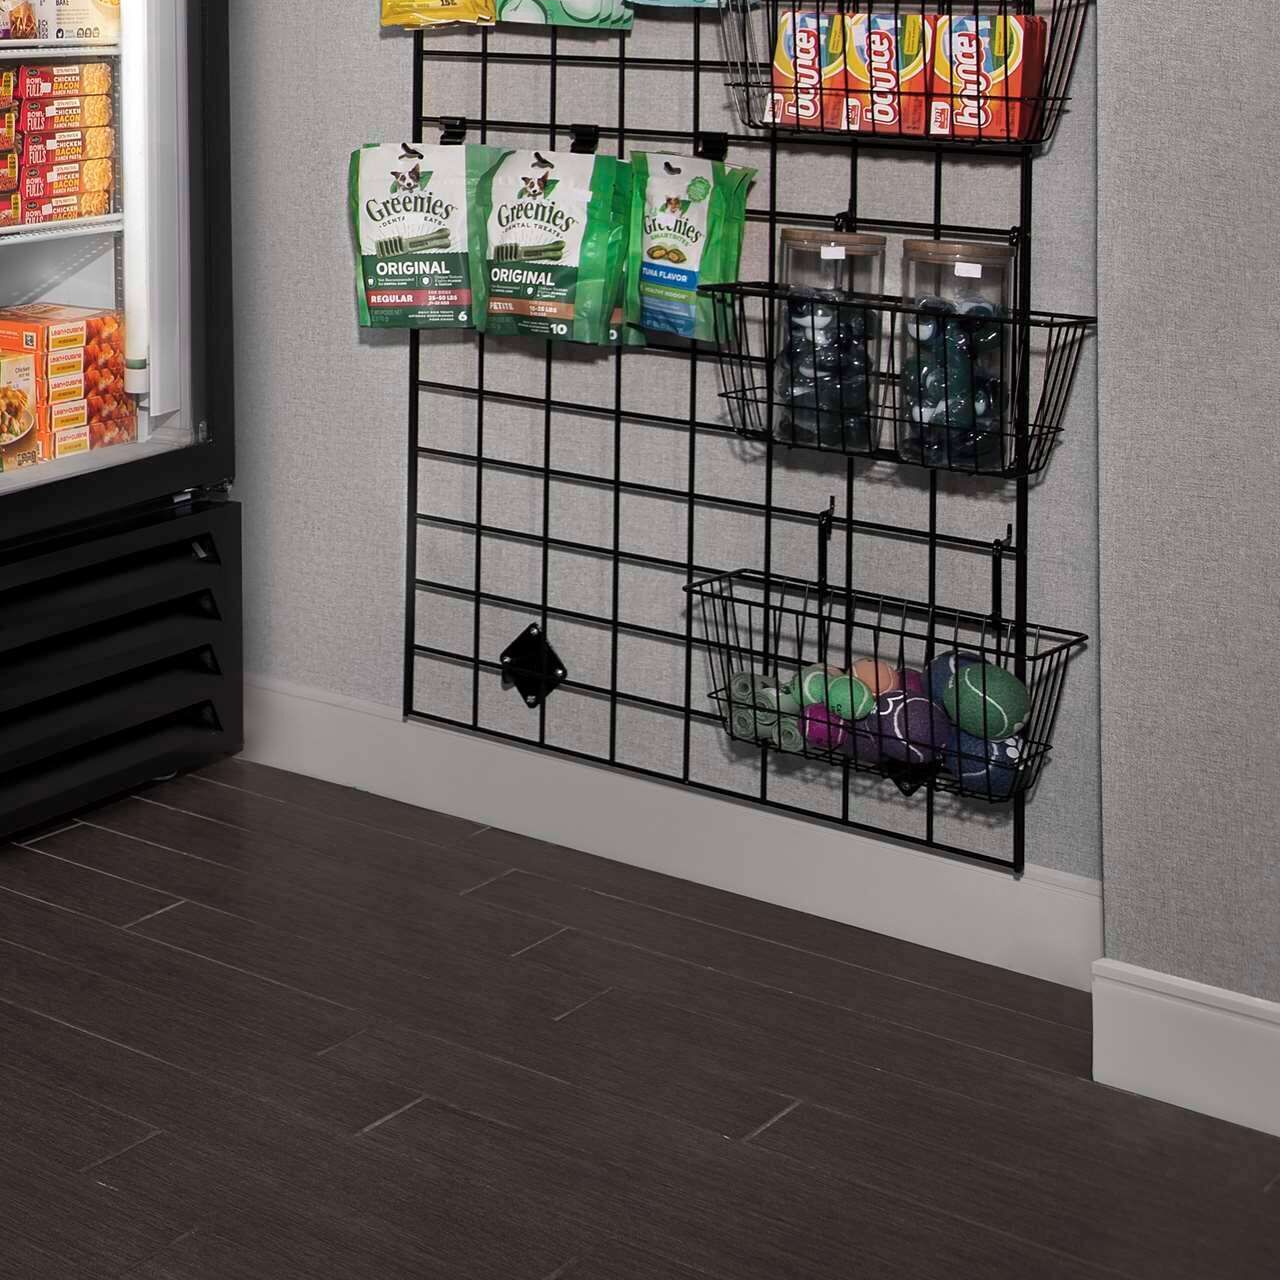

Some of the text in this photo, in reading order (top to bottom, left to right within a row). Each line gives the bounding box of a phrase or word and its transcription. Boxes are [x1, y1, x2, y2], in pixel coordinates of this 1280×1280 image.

[53, 82, 80, 90] BACON
[27, 117, 45, 131] FULLS
[54, 114, 80, 123] BACON
[29, 150, 46, 164] FULLS
[55, 147, 82, 155] BACON
[53, 179, 79, 187] BACON
[26, 183, 44, 198] FULLS
[366, 191, 454, 222] Greenies
[497, 201, 574, 233] Greenies
[376, 261, 450, 276] ORIGINAL
[491, 268, 555, 287] ORIGINAL
[659, 270, 689, 283] FLAVOR
[371, 295, 413, 304] REGULAR
[458, 311, 467, 322] 6
[550, 323, 568, 335] 10
